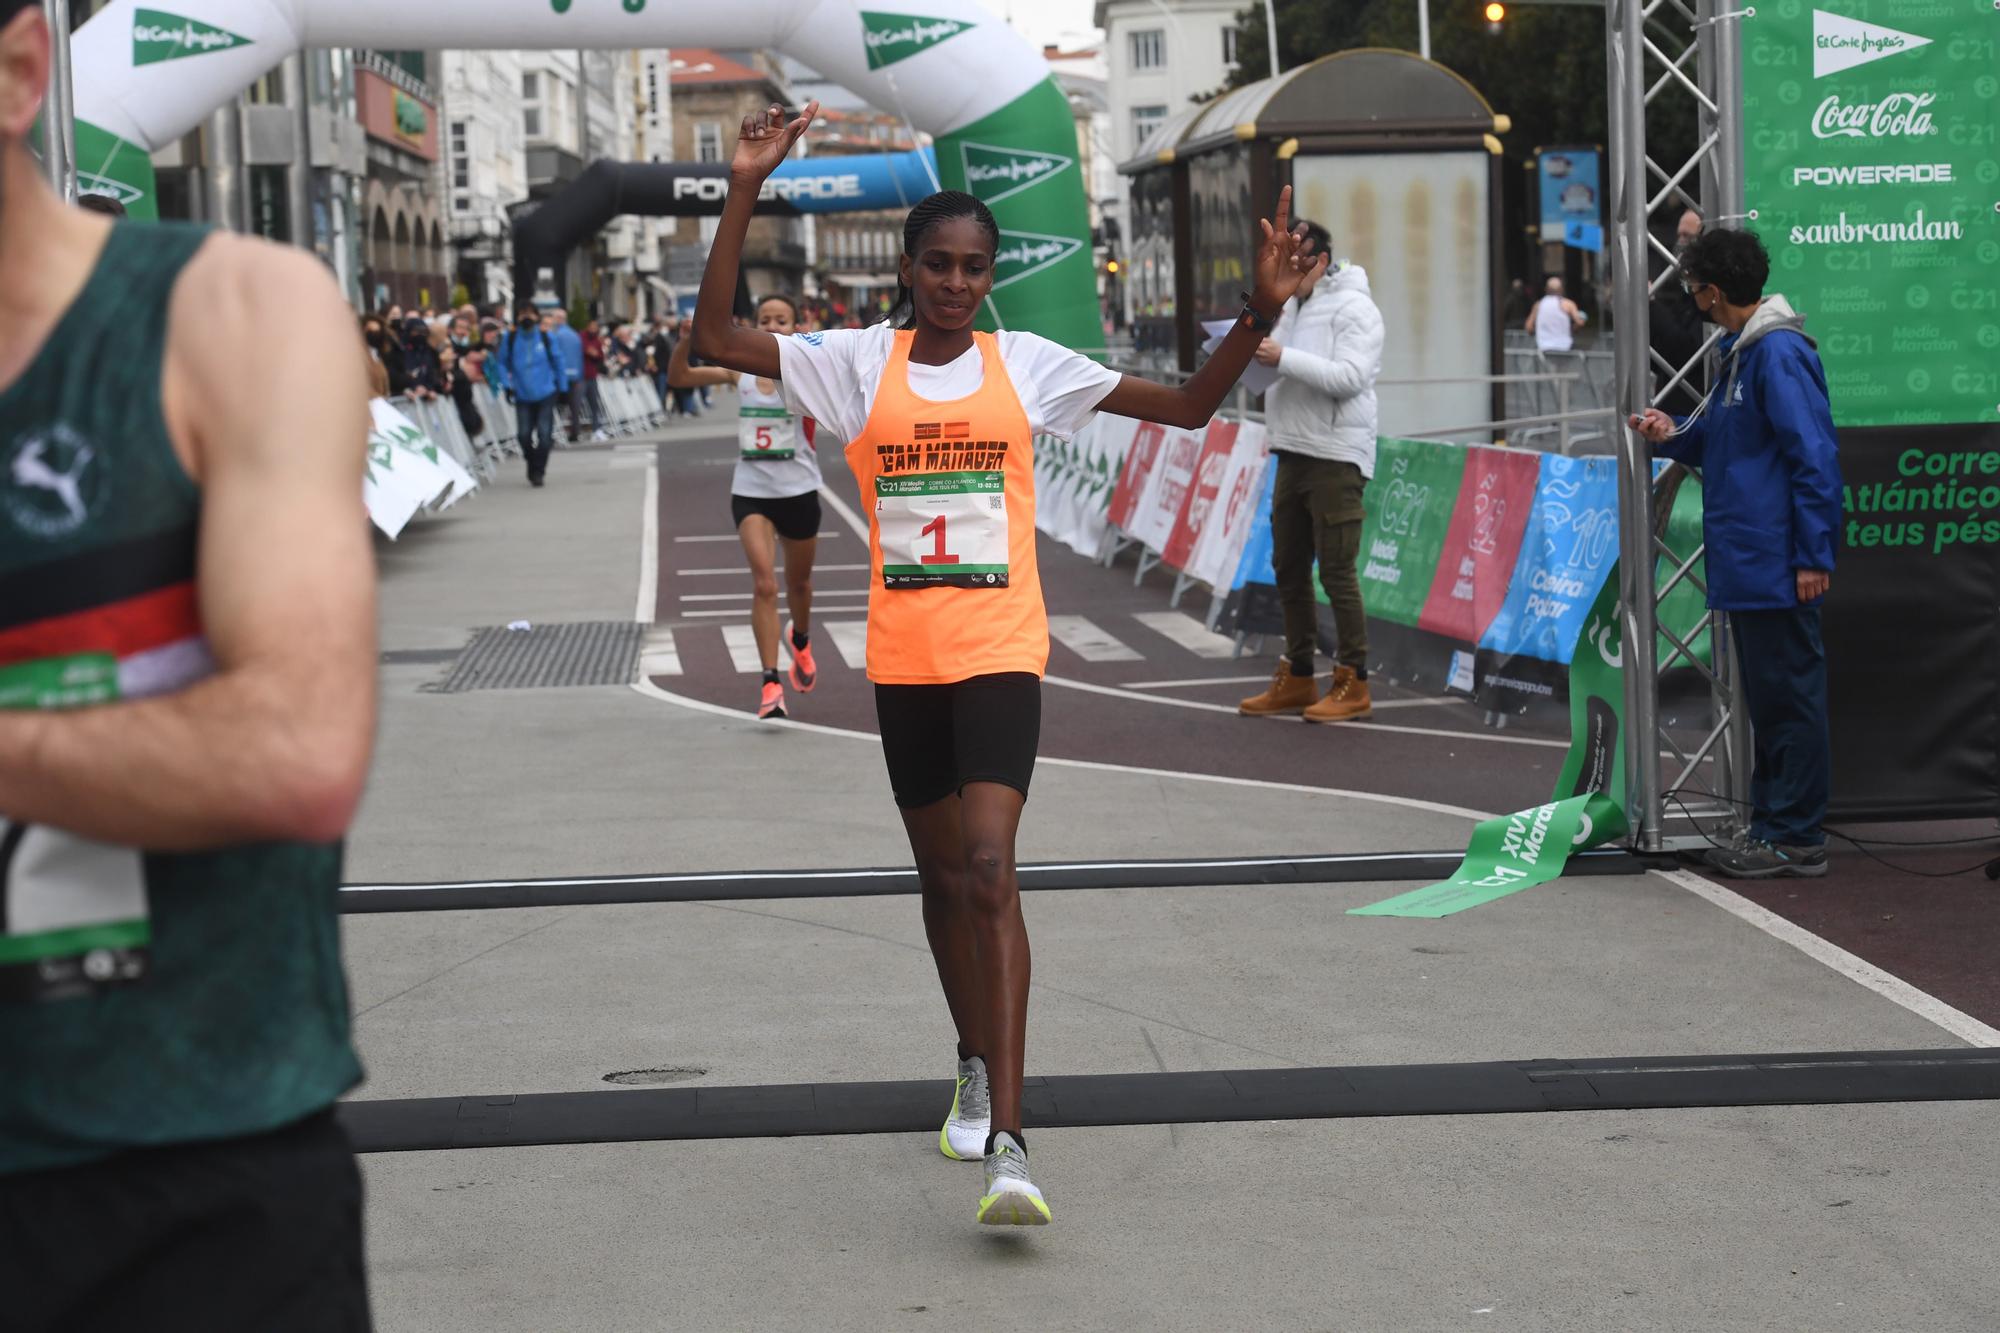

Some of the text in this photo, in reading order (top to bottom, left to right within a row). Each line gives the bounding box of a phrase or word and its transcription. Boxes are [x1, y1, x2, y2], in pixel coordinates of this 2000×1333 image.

[1817, 31, 1904, 52] El Corte Inglés
[1812, 93, 1936, 138] Coca-Cola
[1794, 164, 1953, 186] POWERADE
[1789, 209, 1964, 244] sanbrandan
[755, 426, 772, 451] 5
[1898, 448, 2000, 477] Corre
[920, 515, 960, 564] 1
[1846, 512, 2000, 554] teus pés
